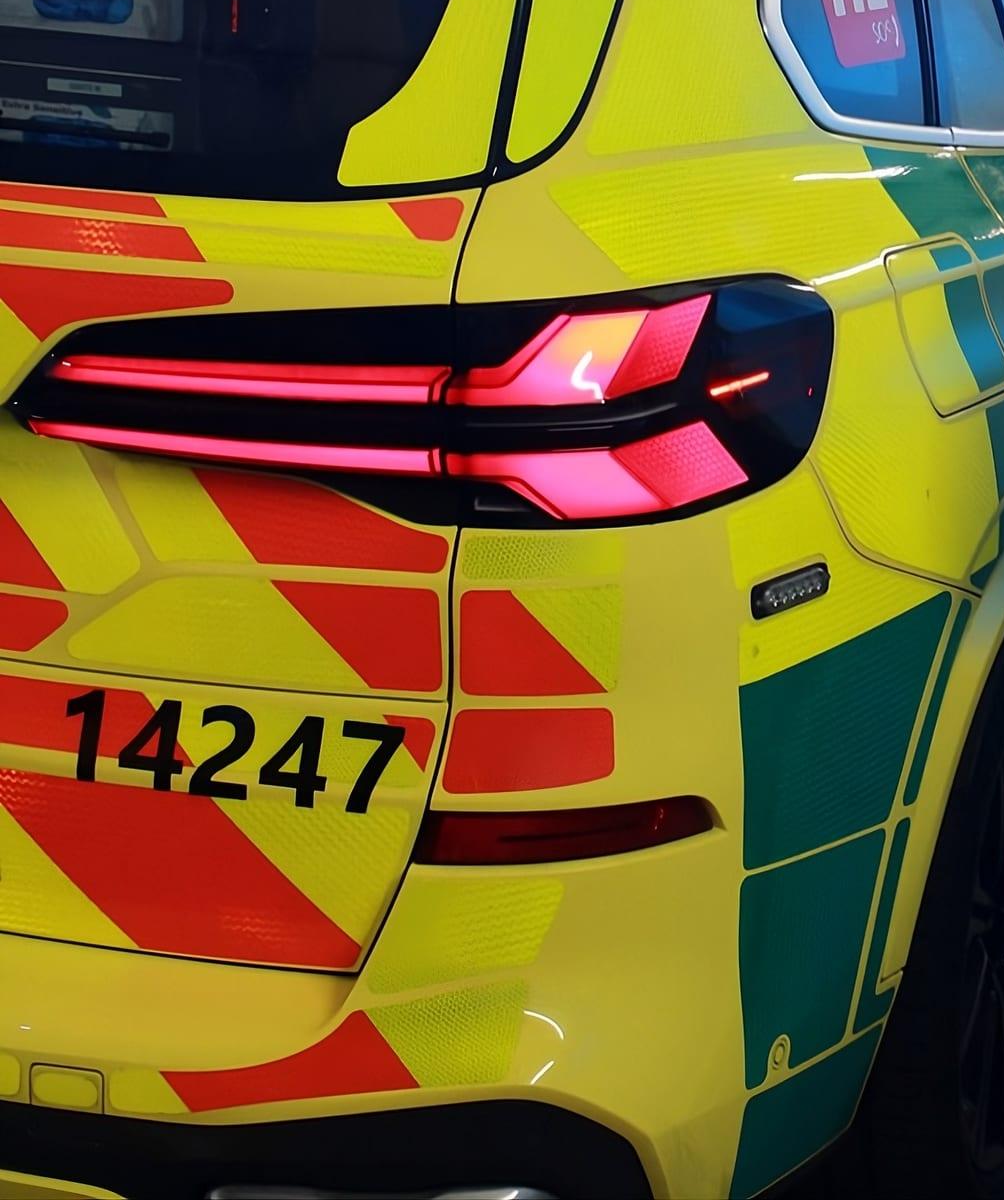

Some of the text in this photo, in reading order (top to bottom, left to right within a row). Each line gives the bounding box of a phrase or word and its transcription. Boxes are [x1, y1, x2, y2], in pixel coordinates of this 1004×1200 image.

[1, 100, 83, 117] Extra Sensitive
[66, 689, 406, 814] 14247
